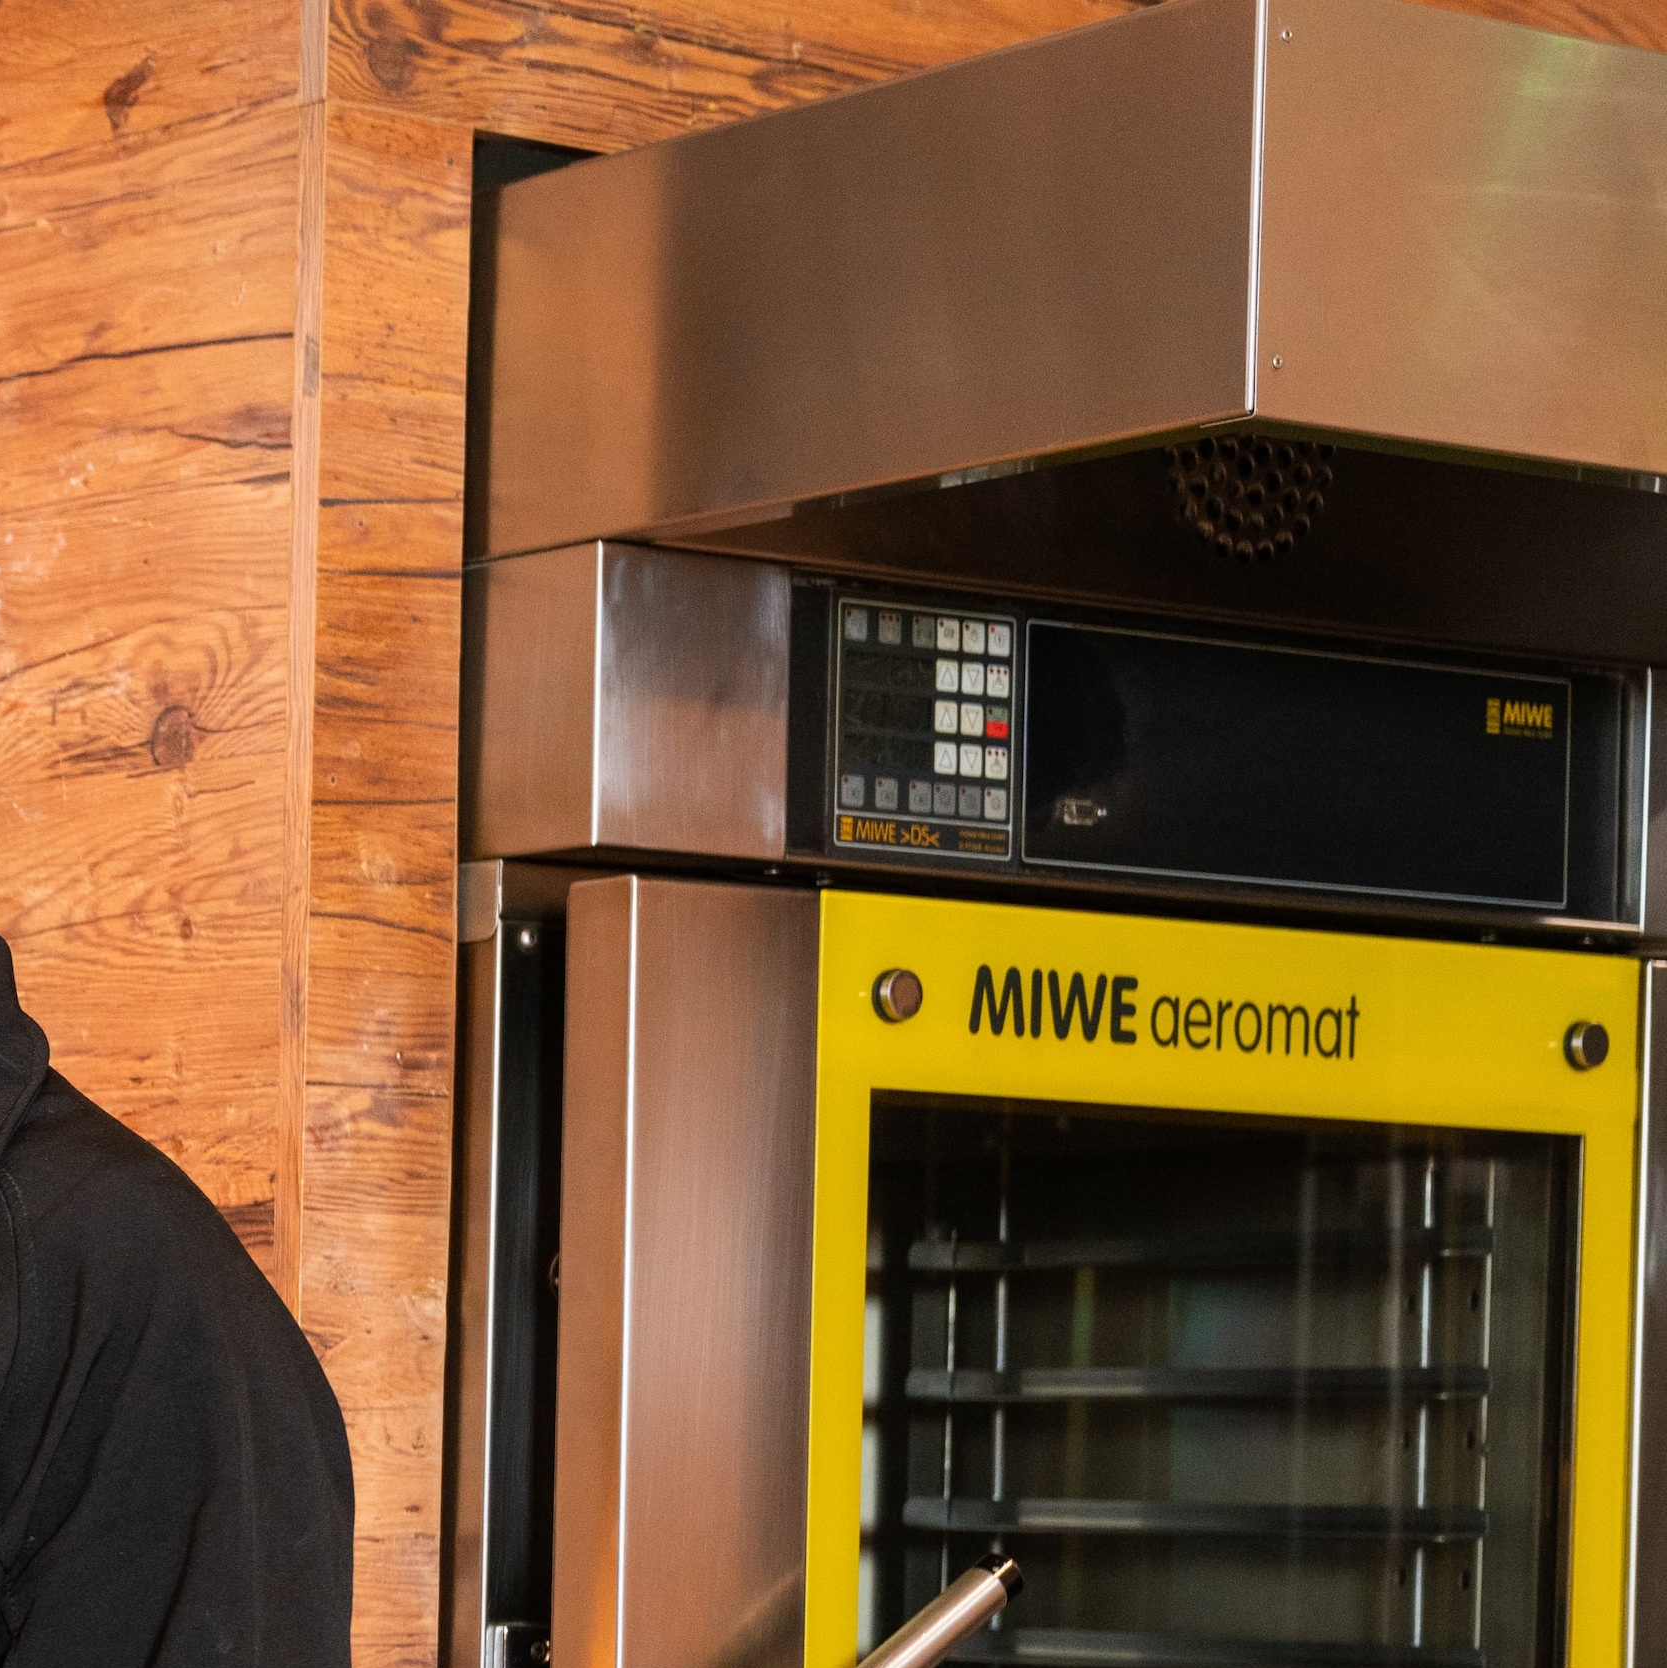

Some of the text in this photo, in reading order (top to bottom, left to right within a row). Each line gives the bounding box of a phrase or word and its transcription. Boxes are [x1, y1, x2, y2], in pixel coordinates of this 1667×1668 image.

[855, 818, 897, 844] MIWE
[968, 963, 1361, 1061] MIWE aeromat
